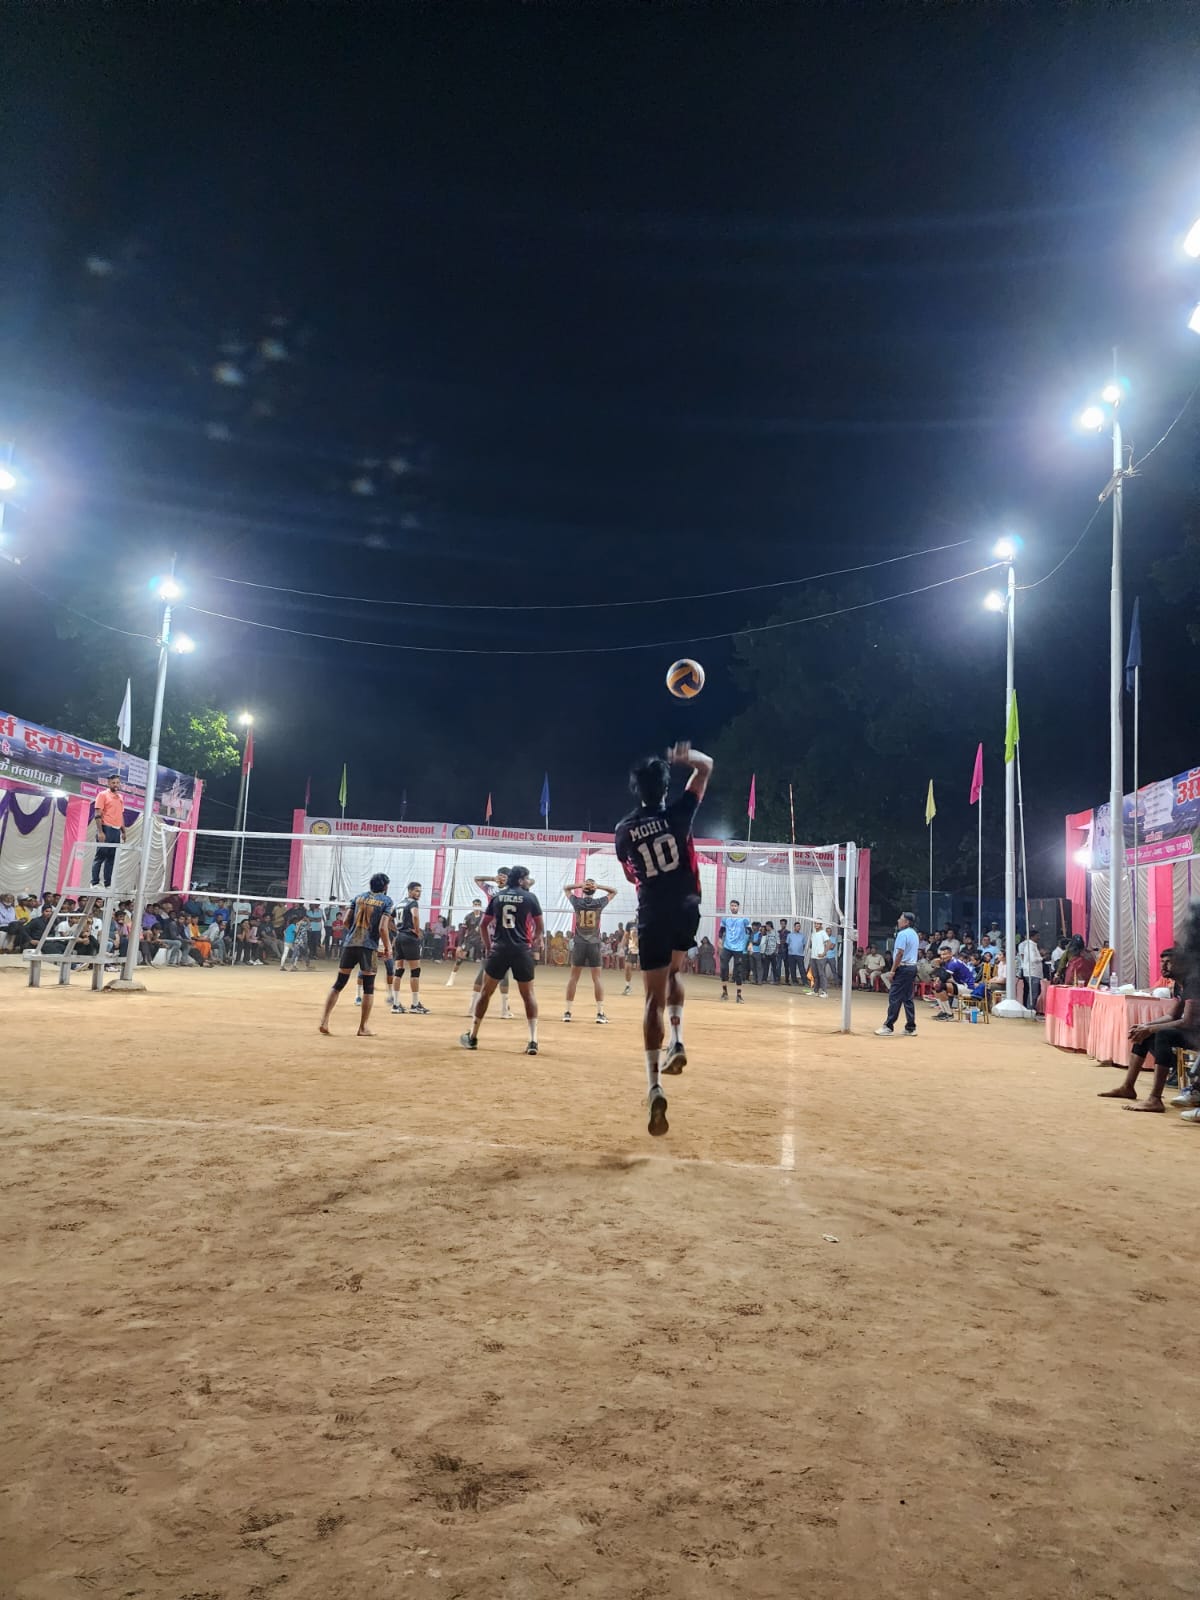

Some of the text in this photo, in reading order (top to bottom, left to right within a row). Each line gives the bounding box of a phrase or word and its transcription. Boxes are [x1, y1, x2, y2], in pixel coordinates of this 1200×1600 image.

[335, 821, 434, 835] Little Angel's Convent
[476, 826, 574, 843] Little Angel's Convent
[637, 833, 680, 878] 10
[498, 894, 524, 904] VIKAS
[502, 904, 517, 929] 6
